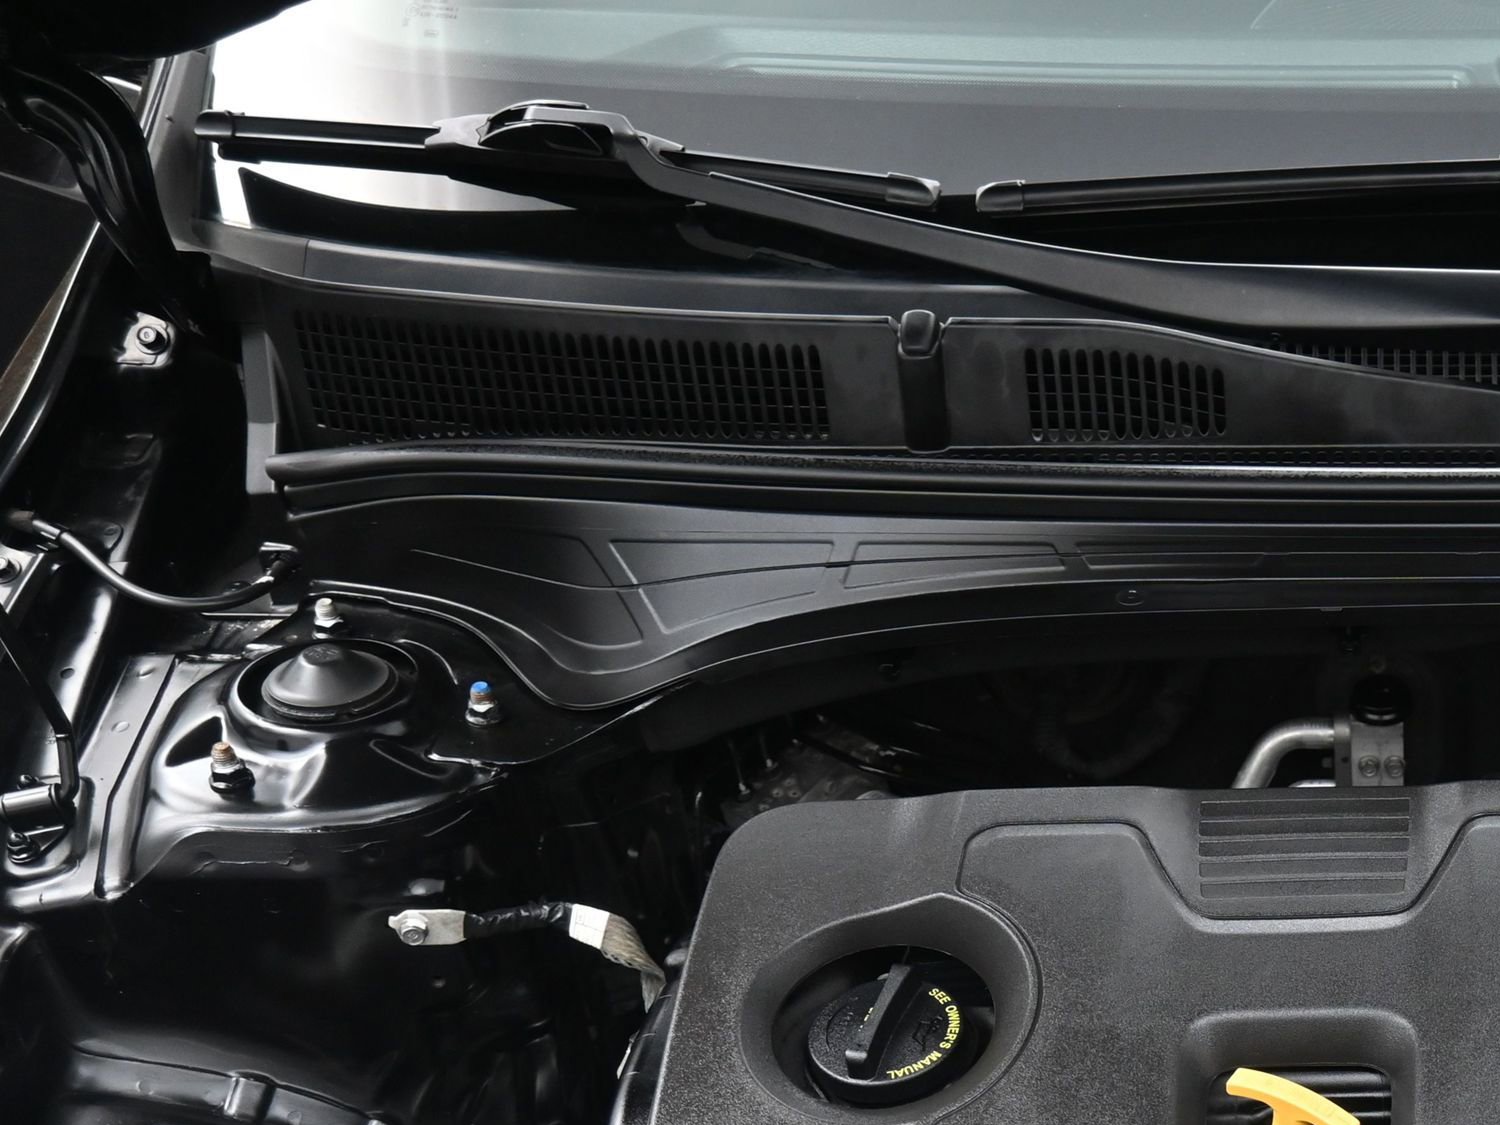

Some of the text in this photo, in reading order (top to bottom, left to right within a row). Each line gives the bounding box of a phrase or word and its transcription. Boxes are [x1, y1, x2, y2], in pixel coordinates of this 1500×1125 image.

[886, 987, 961, 1080] SEE OWNER'S MANUAL
